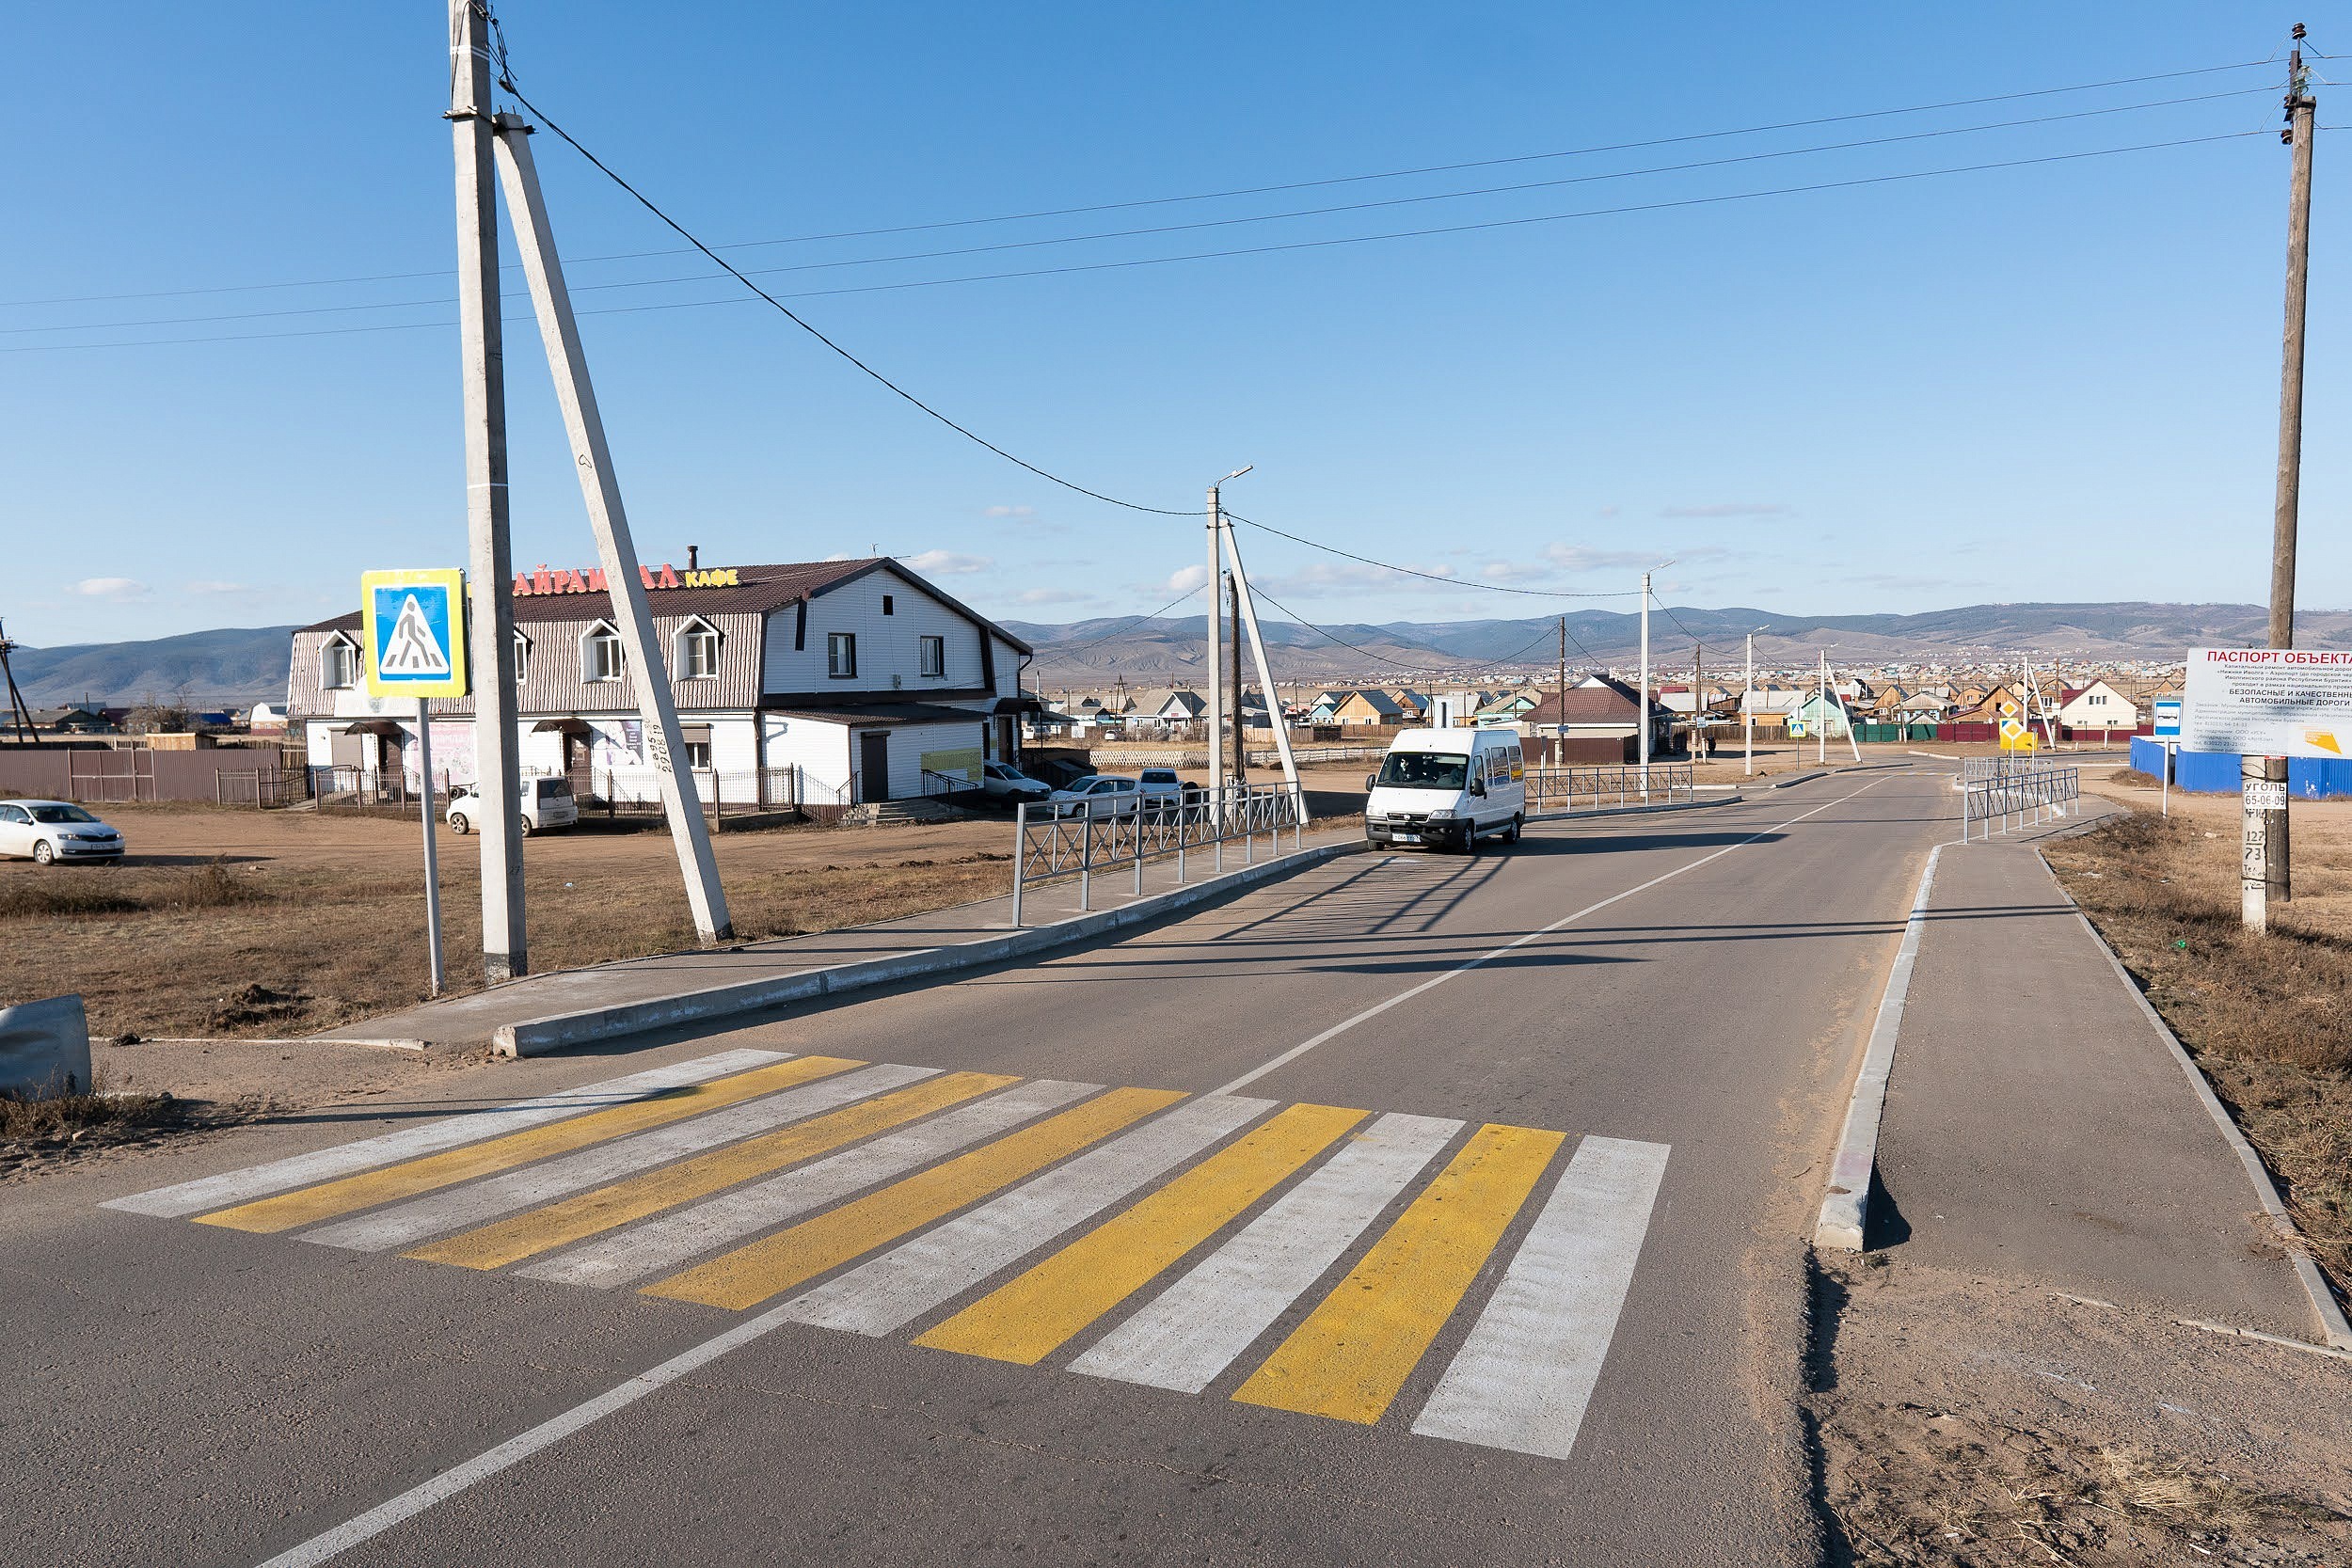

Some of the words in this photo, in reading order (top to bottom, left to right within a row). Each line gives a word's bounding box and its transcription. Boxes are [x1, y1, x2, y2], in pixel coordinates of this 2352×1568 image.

[685, 569, 739, 588] КАФЕ
[2207, 651, 2280, 663] ПАСПОРТ
[2239, 697, 2314, 705] АВТОМОБИЛЬНЫЕ
[2245, 783, 2286, 792] УГОЛЬ
[2245, 795, 2286, 806] 65-06-09
[2247, 831, 2265, 842] 127
[2246, 847, 2262, 861] 73
